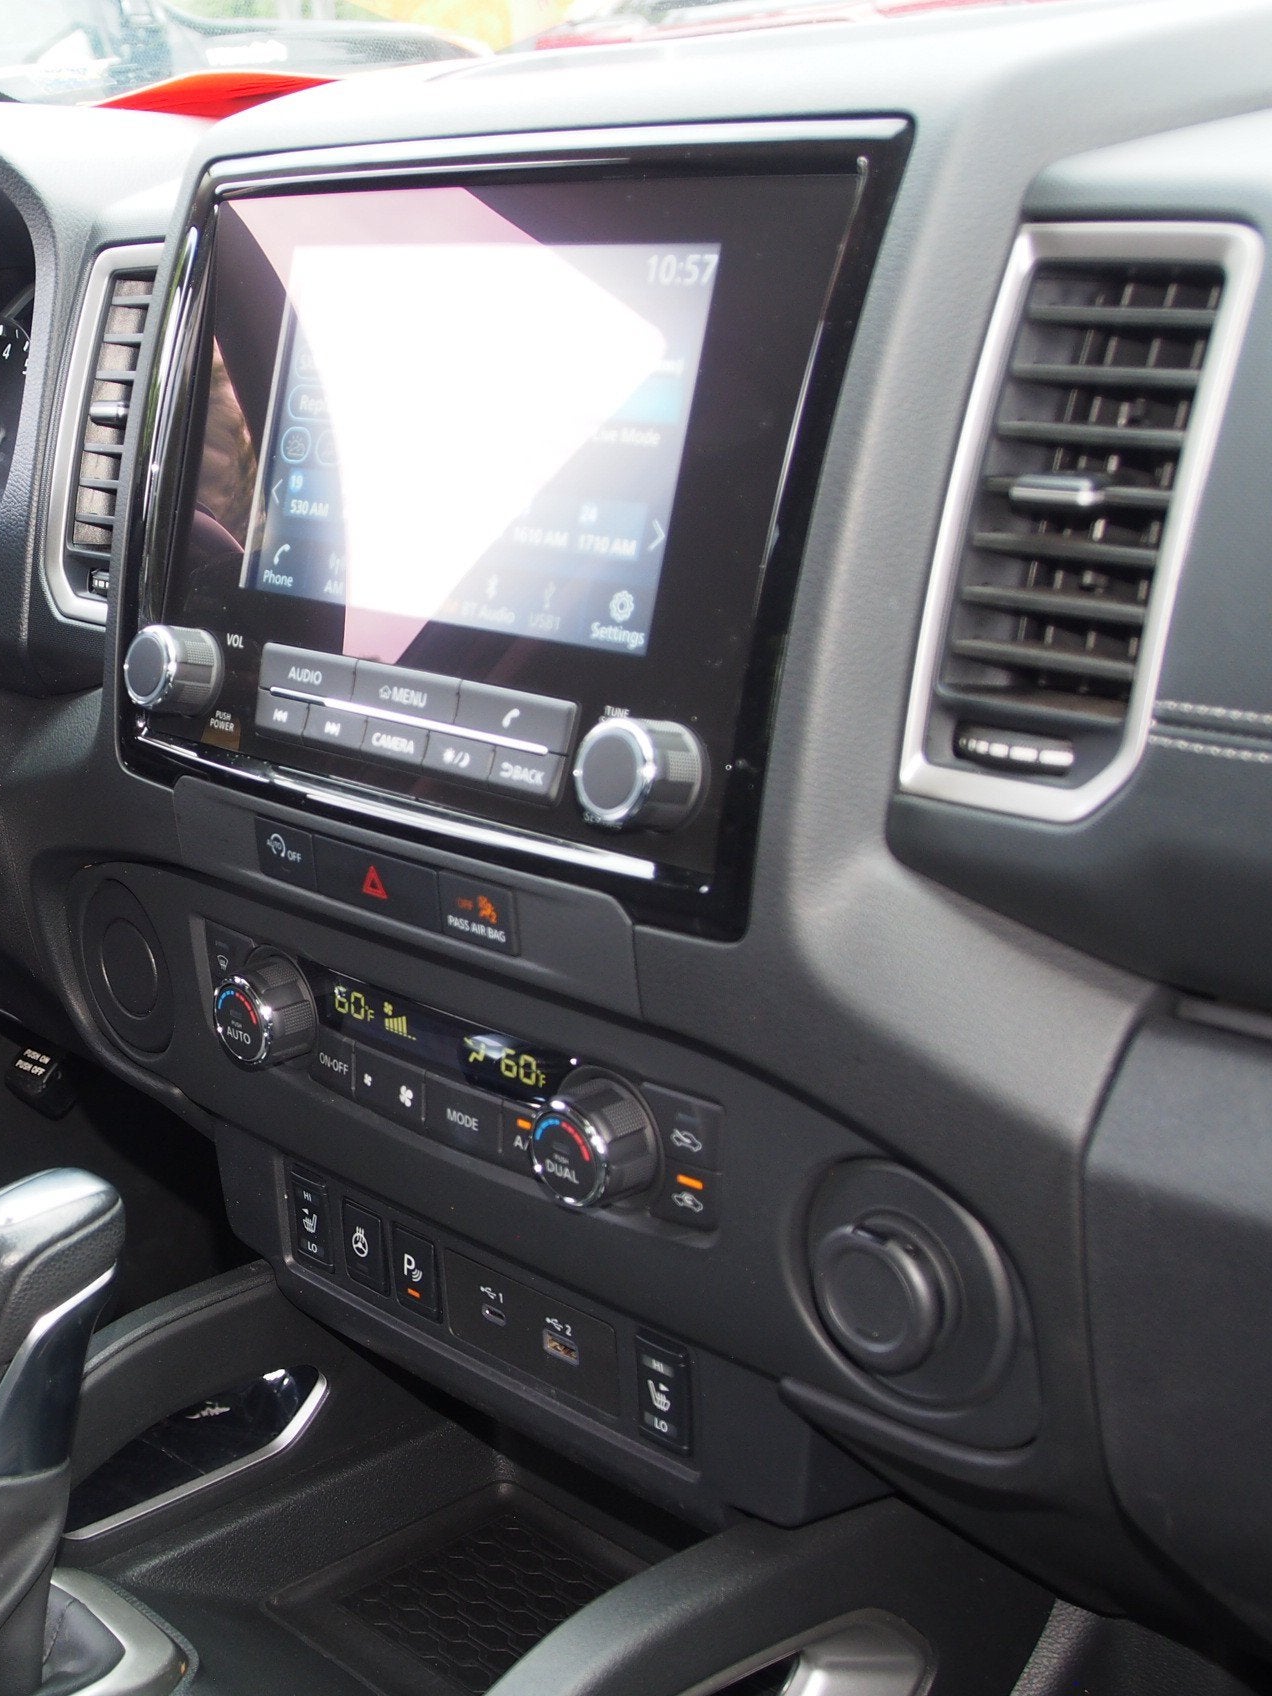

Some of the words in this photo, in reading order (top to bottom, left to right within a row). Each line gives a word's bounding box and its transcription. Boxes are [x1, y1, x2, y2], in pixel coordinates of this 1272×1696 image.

[645, 253, 719, 286] 10:57
[1, 342, 13, 360] 4
[290, 474, 304, 491] 19
[289, 499, 309, 516] 530
[310, 502, 330, 518] AM
[543, 529, 570, 549] AM
[610, 537, 638, 556] AM
[262, 569, 294, 588] Phone
[323, 579, 345, 595] AM
[479, 604, 516, 625] Audio
[226, 633, 245, 649] VOL
[590, 620, 645, 650] Settings
[288, 666, 323, 686] AUDIO
[391, 686, 428, 708] MENU
[215, 709, 232, 722] PUSH
[604, 704, 630, 719] TUNE
[209, 717, 235, 732] POWER
[371, 732, 416, 755] CAMERA
[511, 764, 546, 786] BACK
[287, 850, 302, 863] OFF
[447, 914, 471, 932] PASS
[470, 922, 487, 936] AIR
[487, 926, 507, 943] BAG
[226, 1026, 252, 1045] AUTO
[446, 1108, 479, 1132] MODE
[513, 1134, 531, 1152] A/
[544, 1158, 580, 1185] DUAL
[302, 1190, 312, 1202] HI
[307, 1241, 319, 1254] LO
[563, 1324, 572, 1337] 2
[651, 1359, 664, 1374] HI
[653, 1417, 668, 1433] LO
